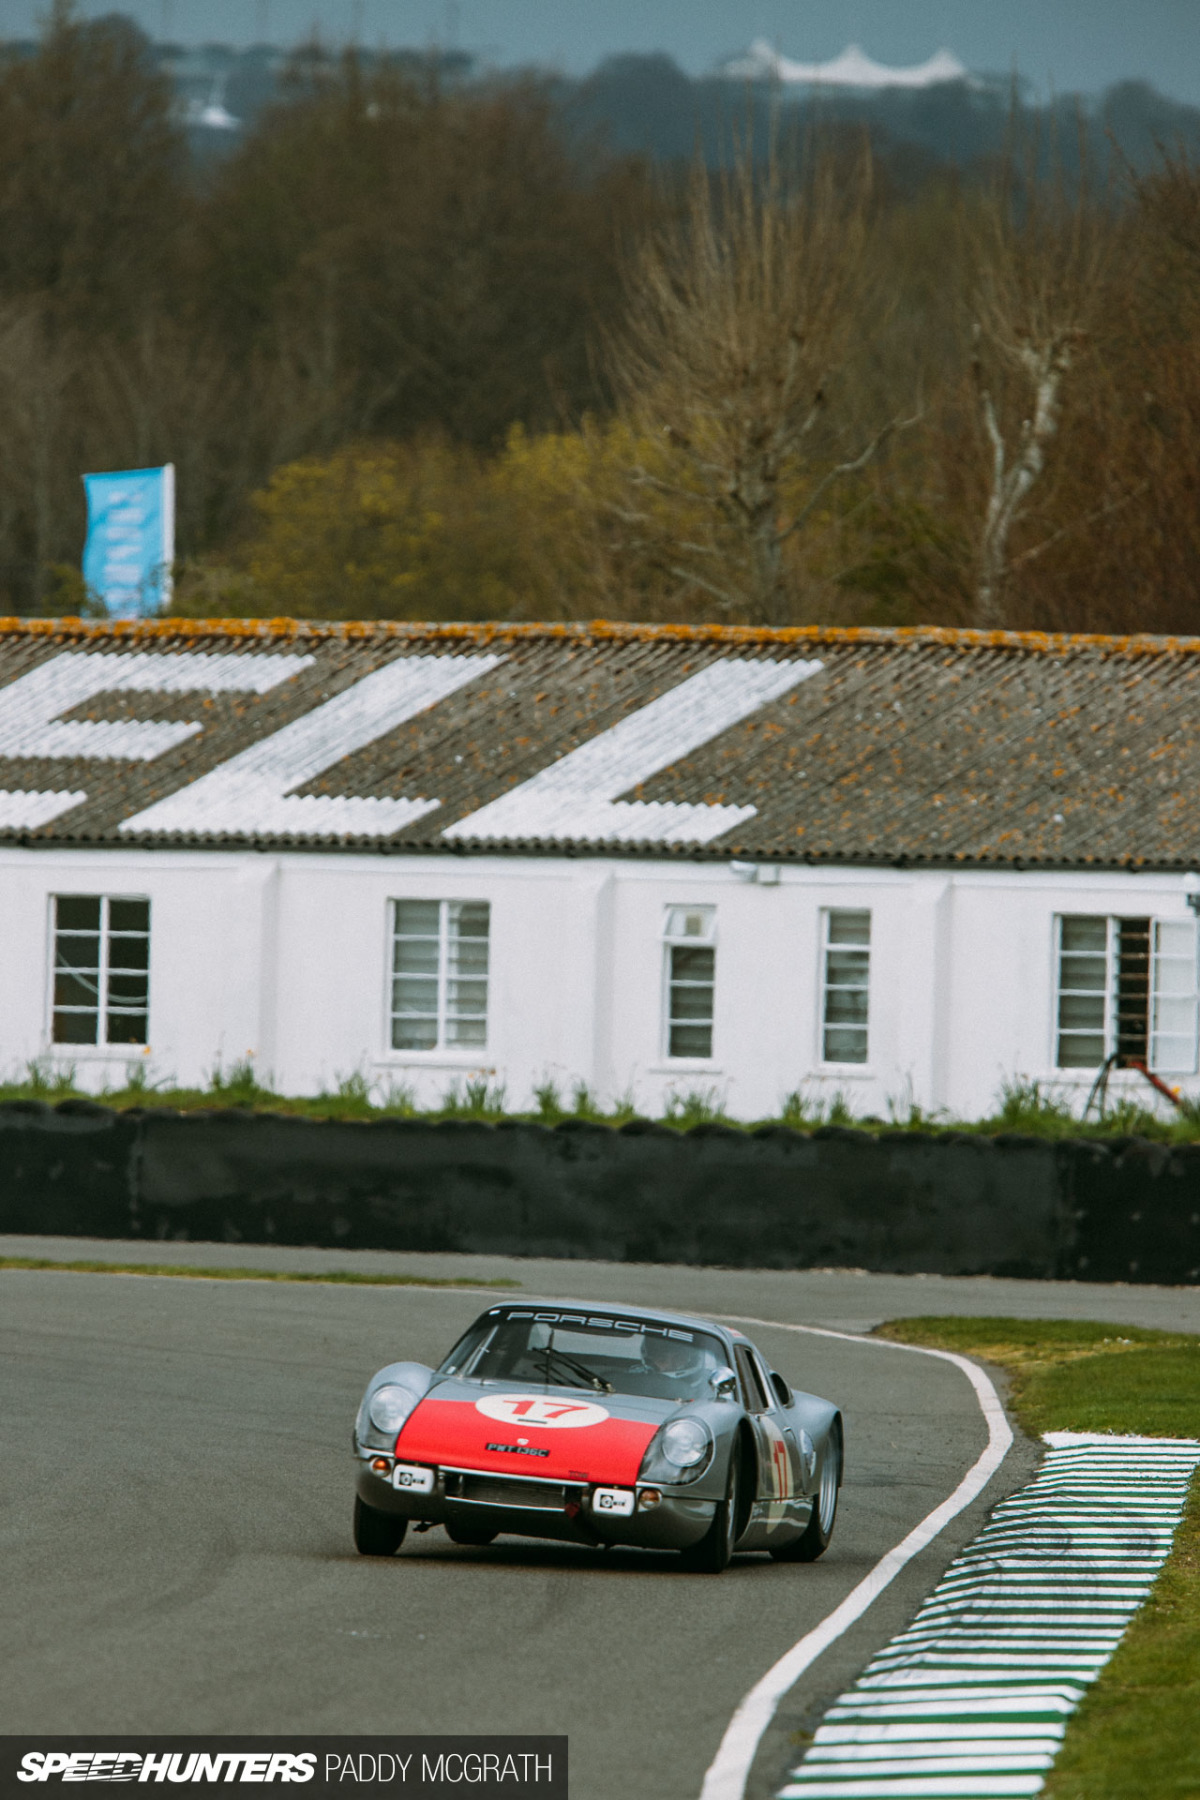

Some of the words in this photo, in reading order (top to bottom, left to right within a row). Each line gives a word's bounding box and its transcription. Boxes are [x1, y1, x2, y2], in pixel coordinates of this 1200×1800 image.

[507, 1312, 694, 1343] PORSCHE
[503, 1400, 589, 1418] 17
[773, 1440, 788, 1499] 17
